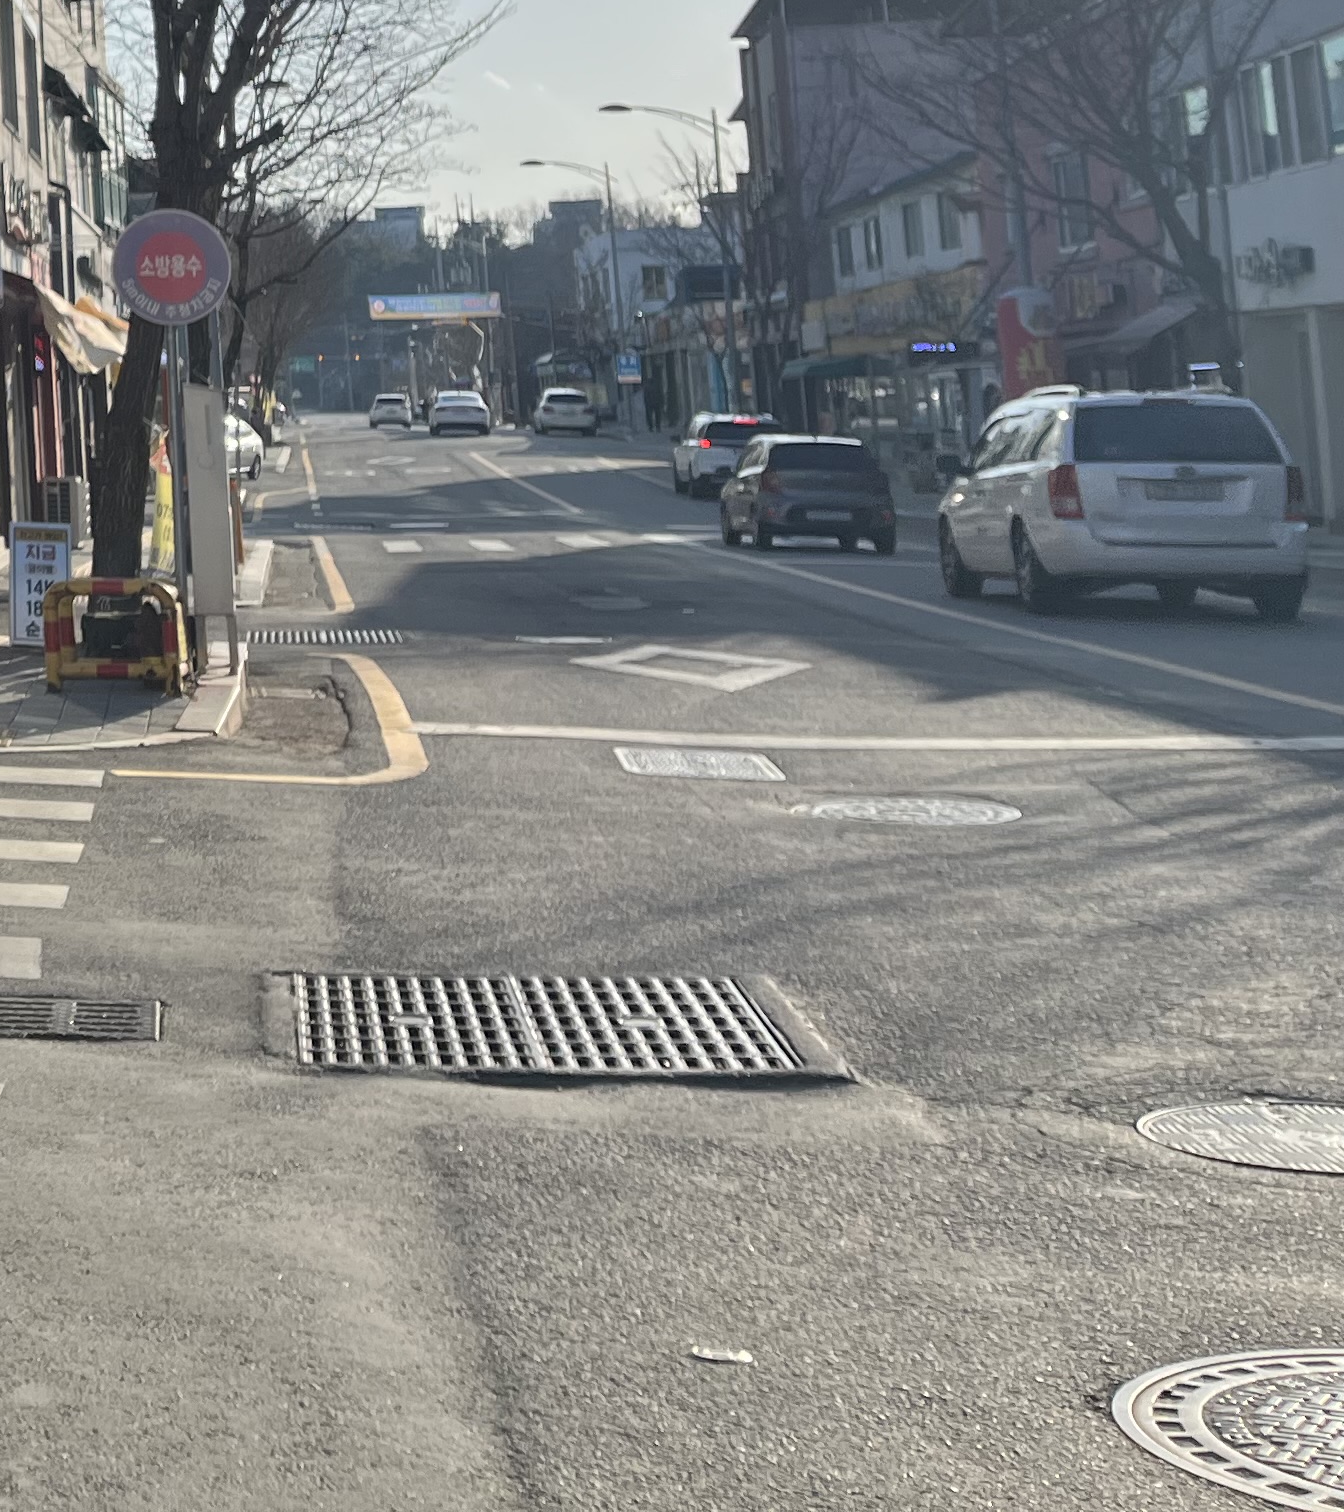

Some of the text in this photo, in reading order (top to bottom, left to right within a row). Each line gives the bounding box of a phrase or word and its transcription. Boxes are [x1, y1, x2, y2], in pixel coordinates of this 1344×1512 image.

[139, 254, 203, 279] 소방용수
[26, 601, 43, 617] 18
[25, 620, 41, 637] 순
